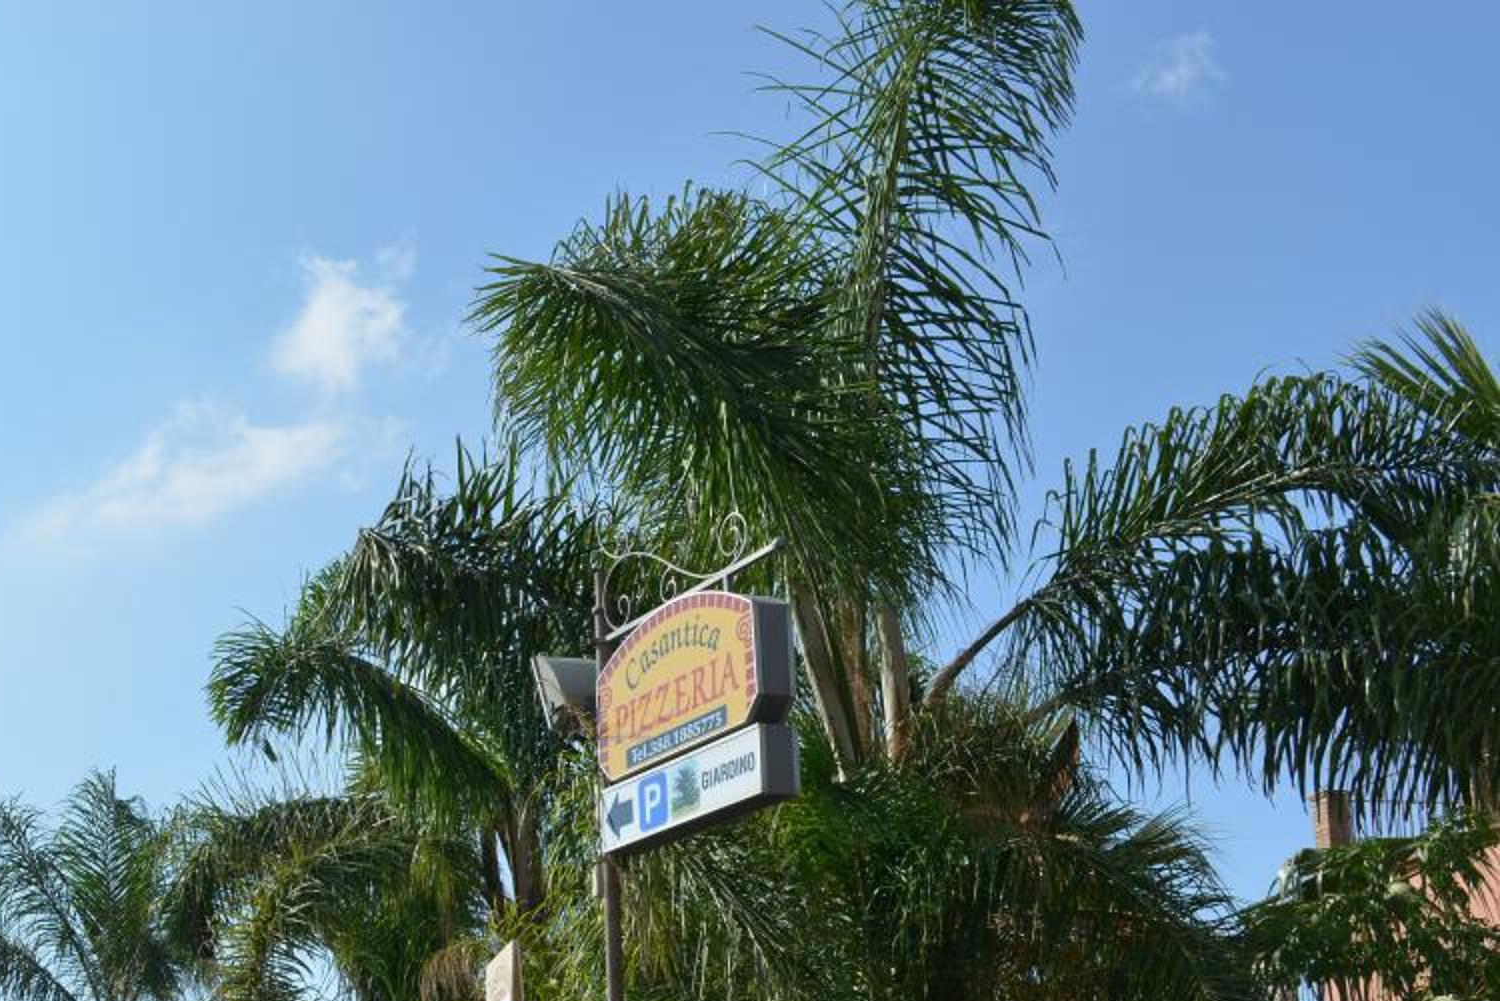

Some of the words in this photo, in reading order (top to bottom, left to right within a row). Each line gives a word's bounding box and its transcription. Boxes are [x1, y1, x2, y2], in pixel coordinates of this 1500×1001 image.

[625, 614, 721, 689] Casantica
[614, 654, 740, 745] PIZZERIA
[646, 783, 660, 824] P
[701, 752, 756, 790] GIARDINO
